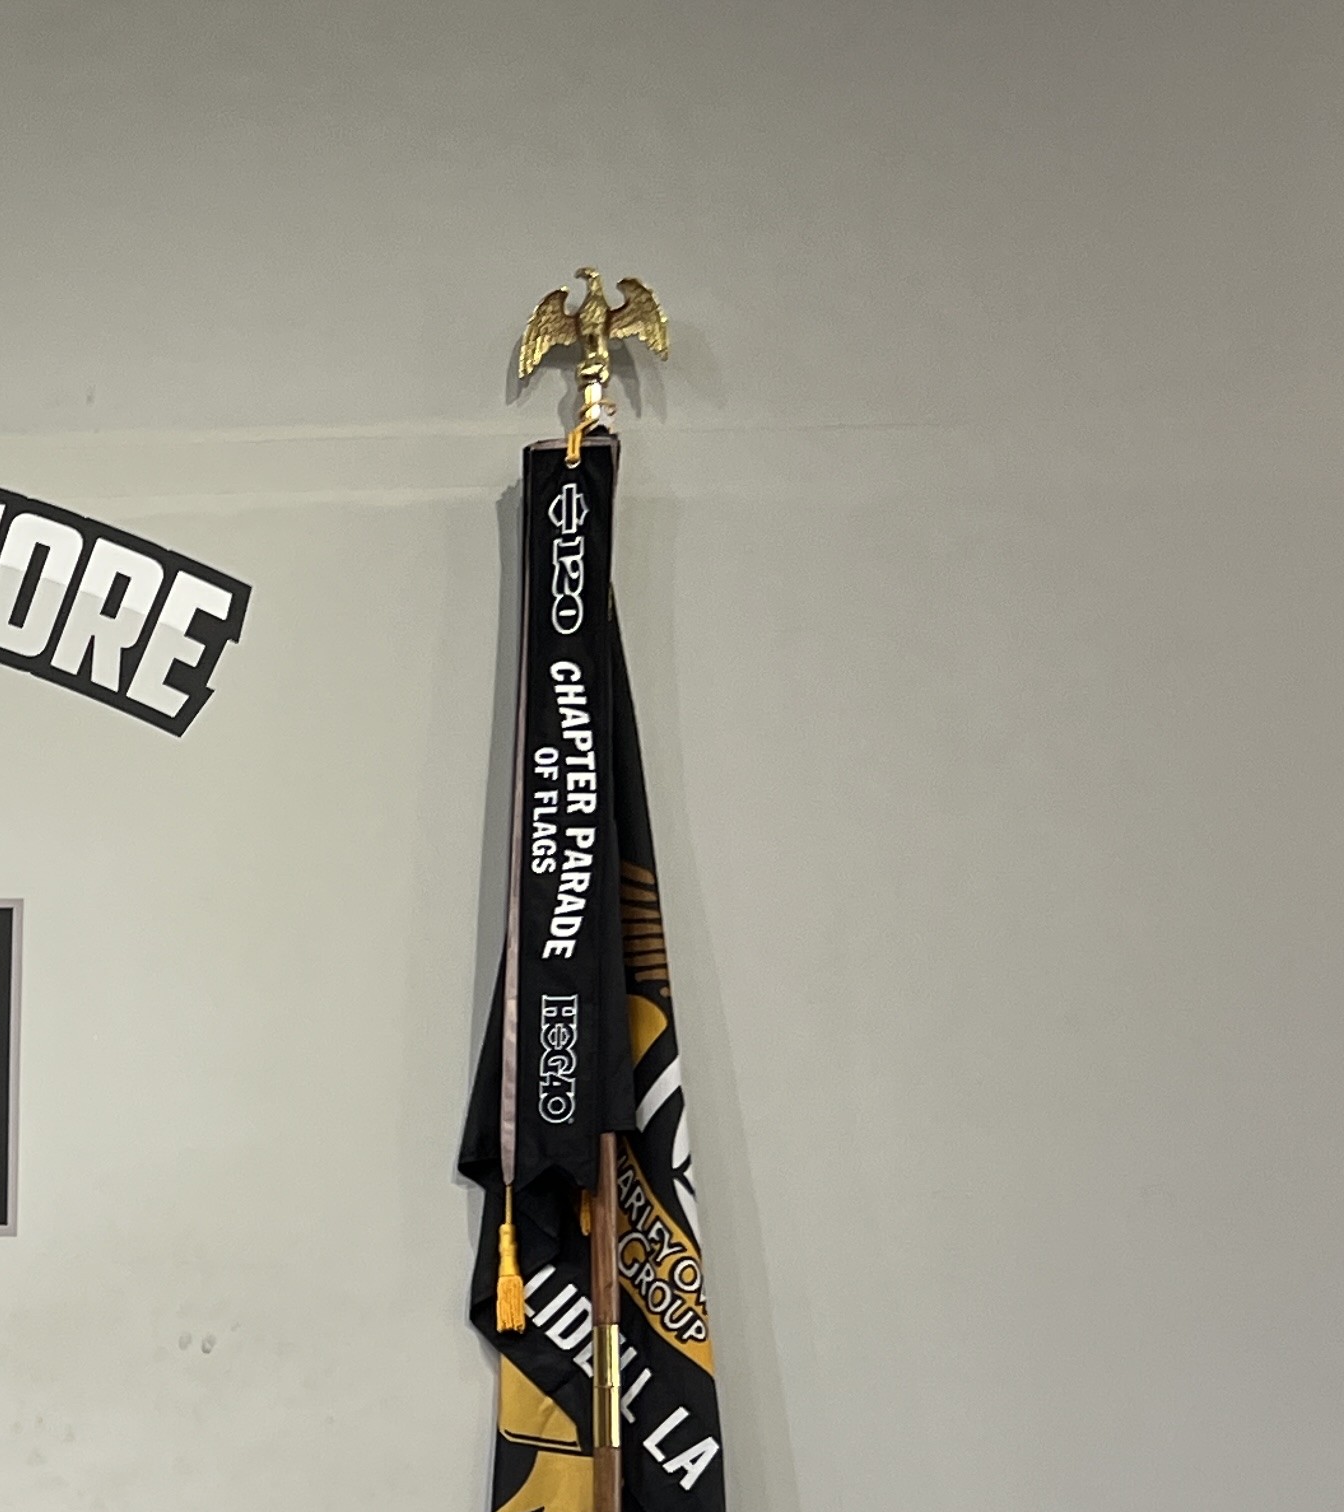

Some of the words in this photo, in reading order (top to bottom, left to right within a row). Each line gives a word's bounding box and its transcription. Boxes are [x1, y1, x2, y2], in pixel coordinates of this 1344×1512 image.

[534, 747, 560, 781] OF
[549, 661, 598, 815] CHAPTER
[531, 789, 559, 874] FLAGS
[542, 827, 598, 959] PARADE
[618, 1231, 707, 1341] GROUP
[643, 1406, 720, 1491] LA
